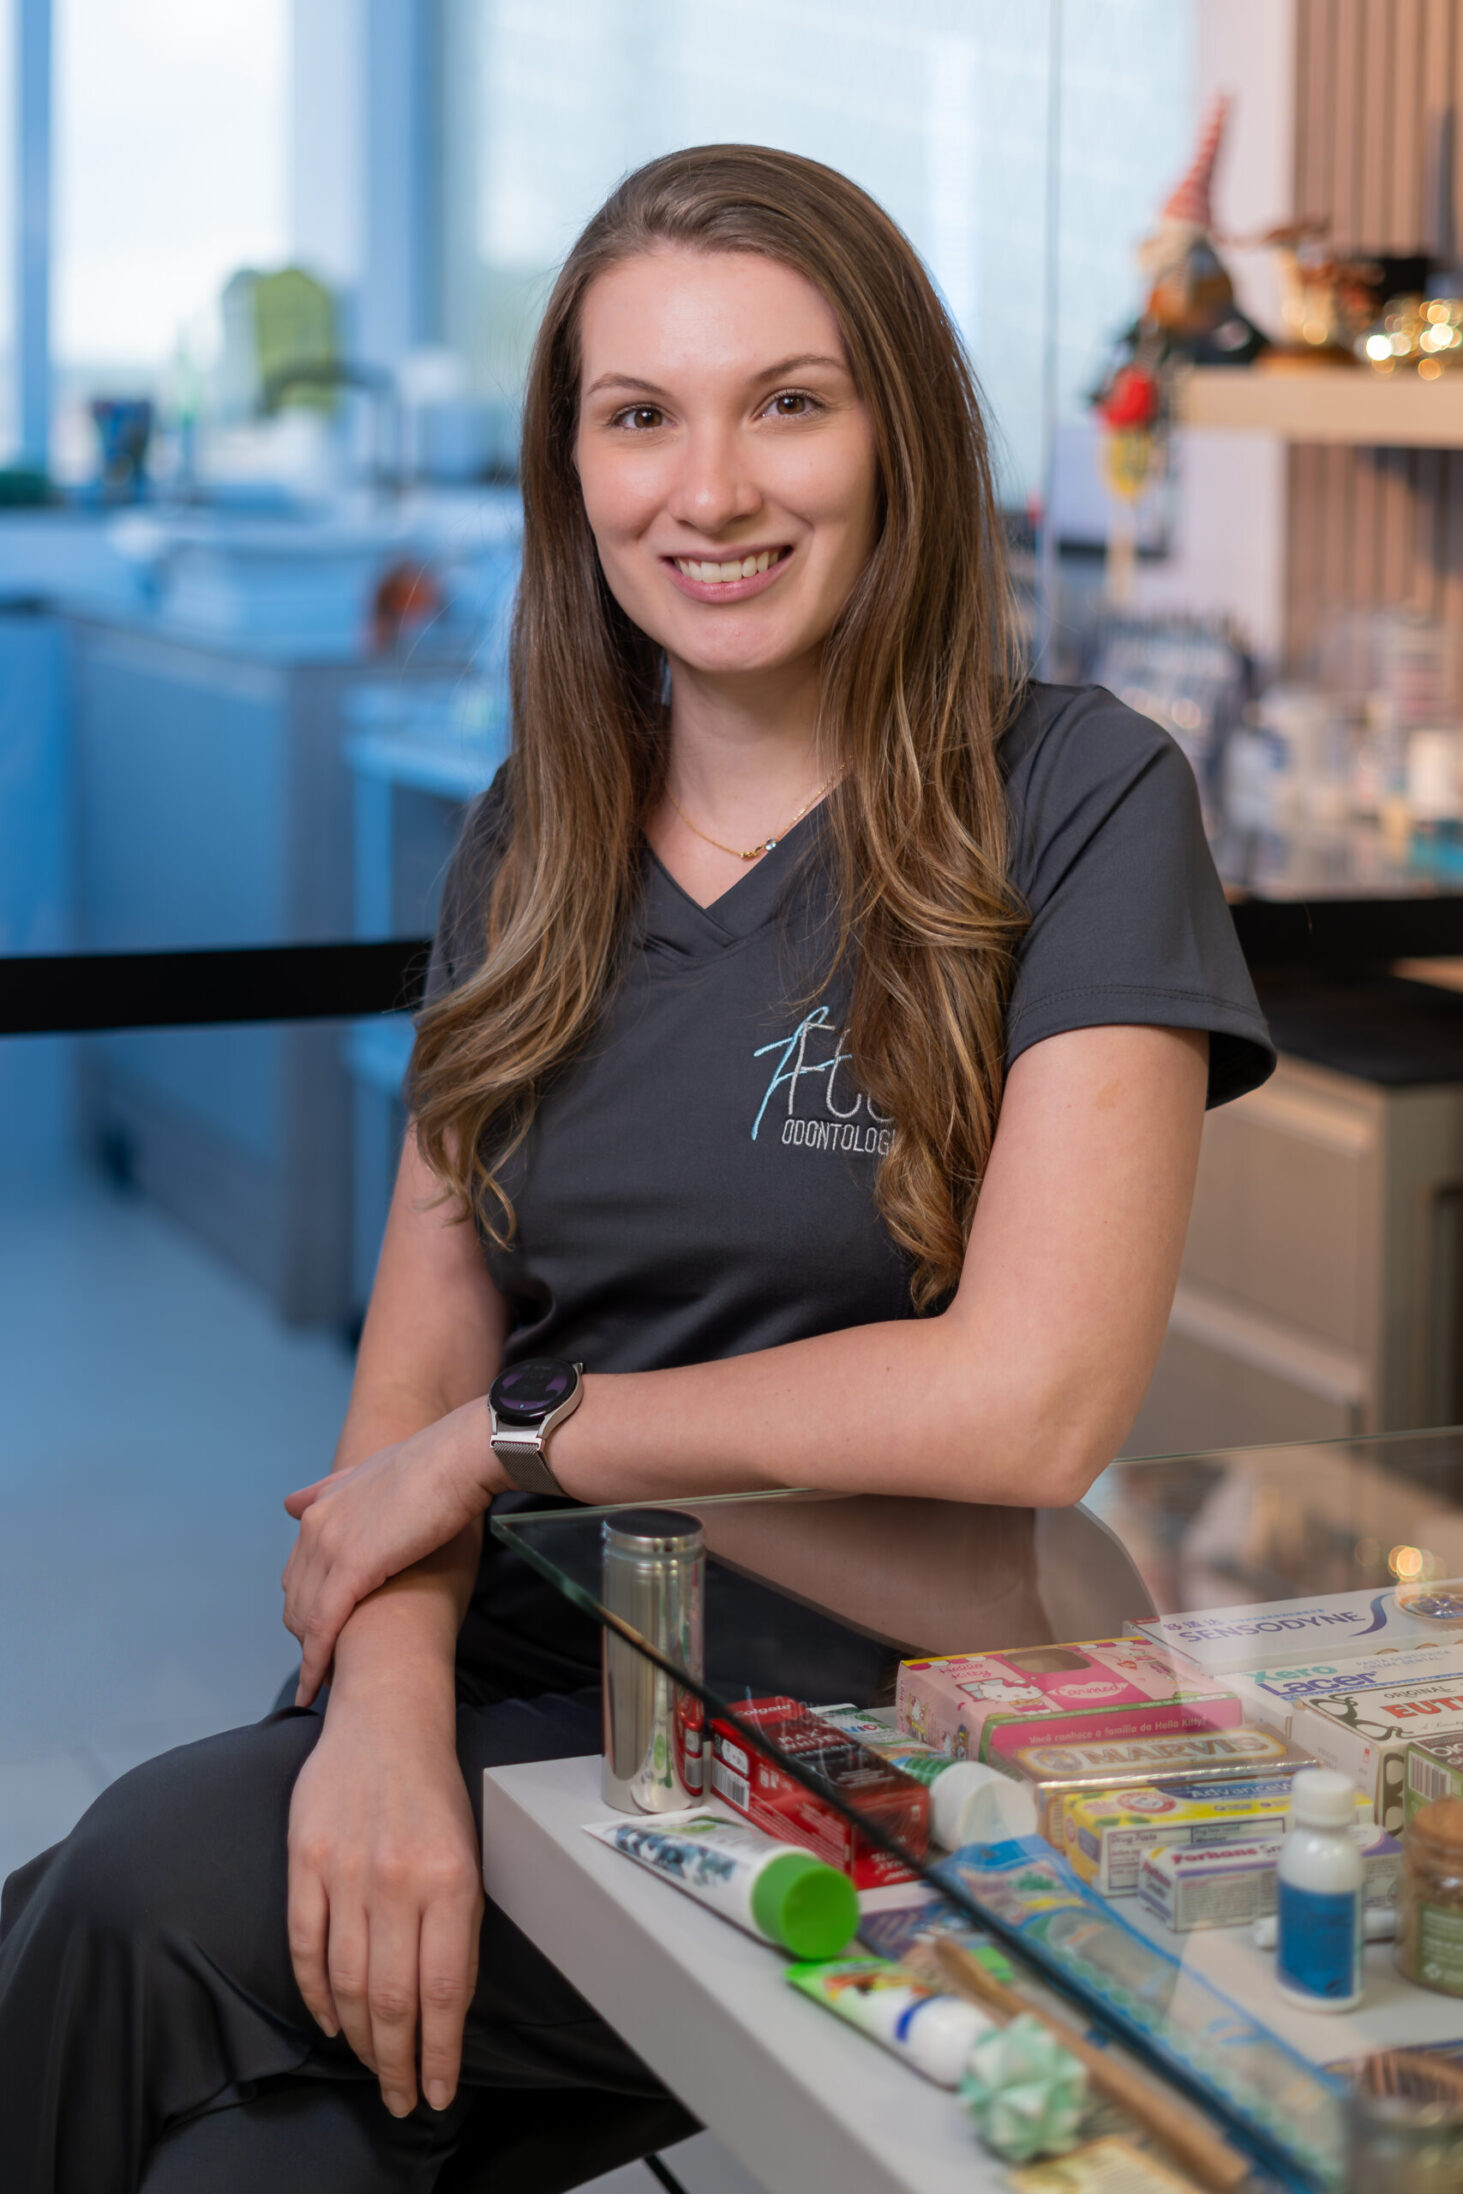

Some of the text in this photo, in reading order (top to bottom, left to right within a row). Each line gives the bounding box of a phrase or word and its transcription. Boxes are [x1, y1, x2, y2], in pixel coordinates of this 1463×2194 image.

[1178, 1611, 1367, 1643] SENSODYNE
[1244, 1665, 1338, 1684] Xero
[1258, 1672, 1378, 1698] Lacer
[1384, 1686, 1453, 1699] ORIGINAL
[1379, 1695, 1463, 1719] EUT
[1079, 1735, 1270, 1766] MARVIS
